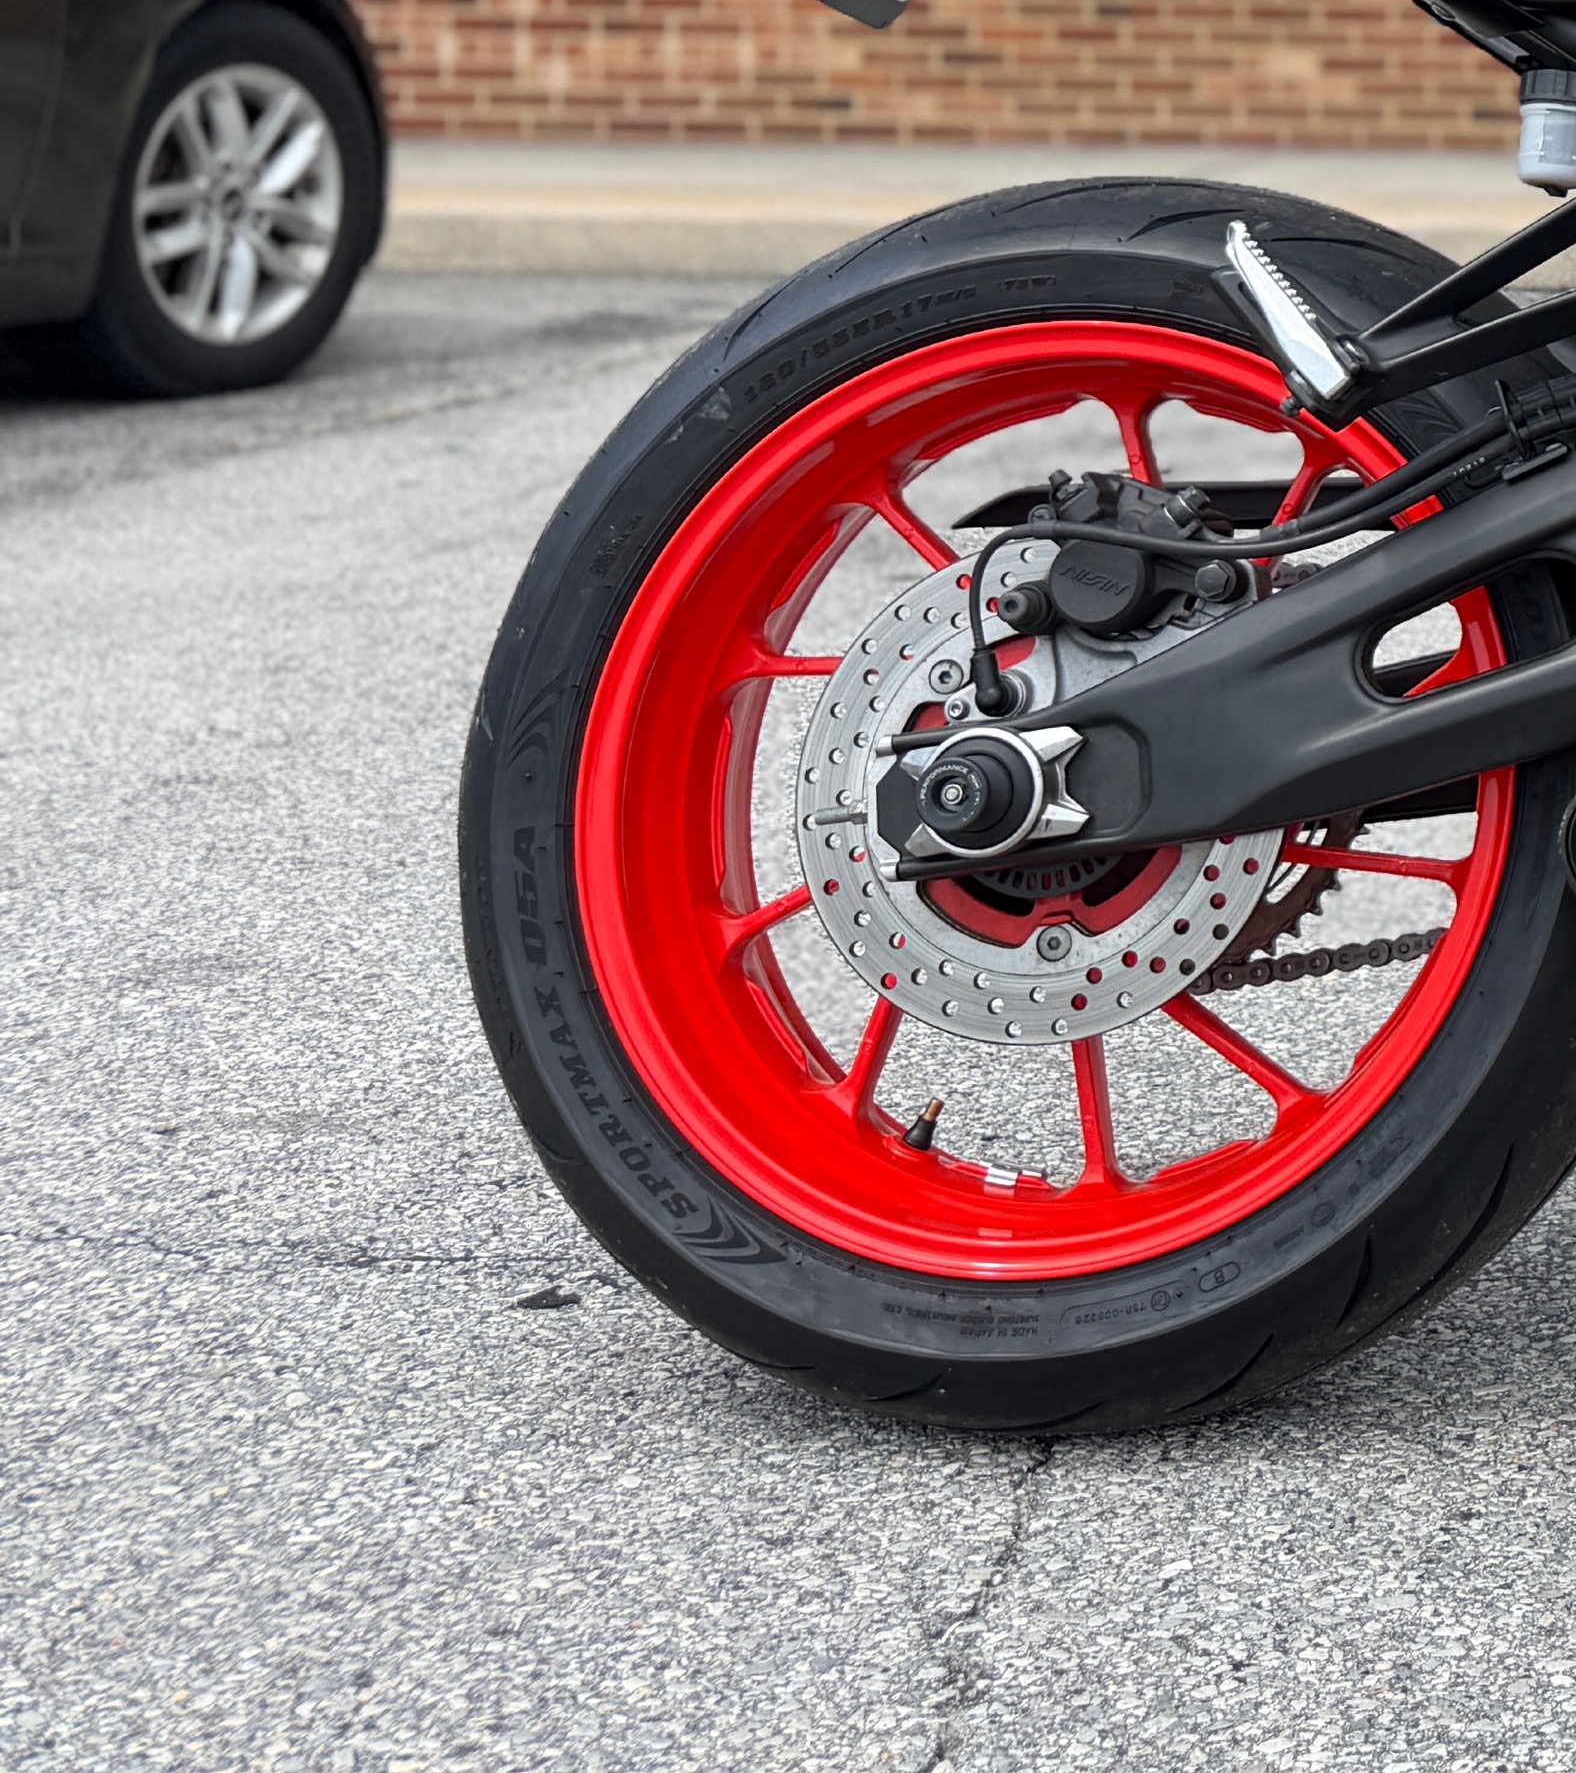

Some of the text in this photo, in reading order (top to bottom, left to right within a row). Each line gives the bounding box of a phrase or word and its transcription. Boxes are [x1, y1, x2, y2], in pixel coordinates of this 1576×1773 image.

[534, 984, 700, 1219] SPORTMAX
[959, 1325, 995, 1338] JAPAN
[1011, 1325, 1039, 1337] MADE
